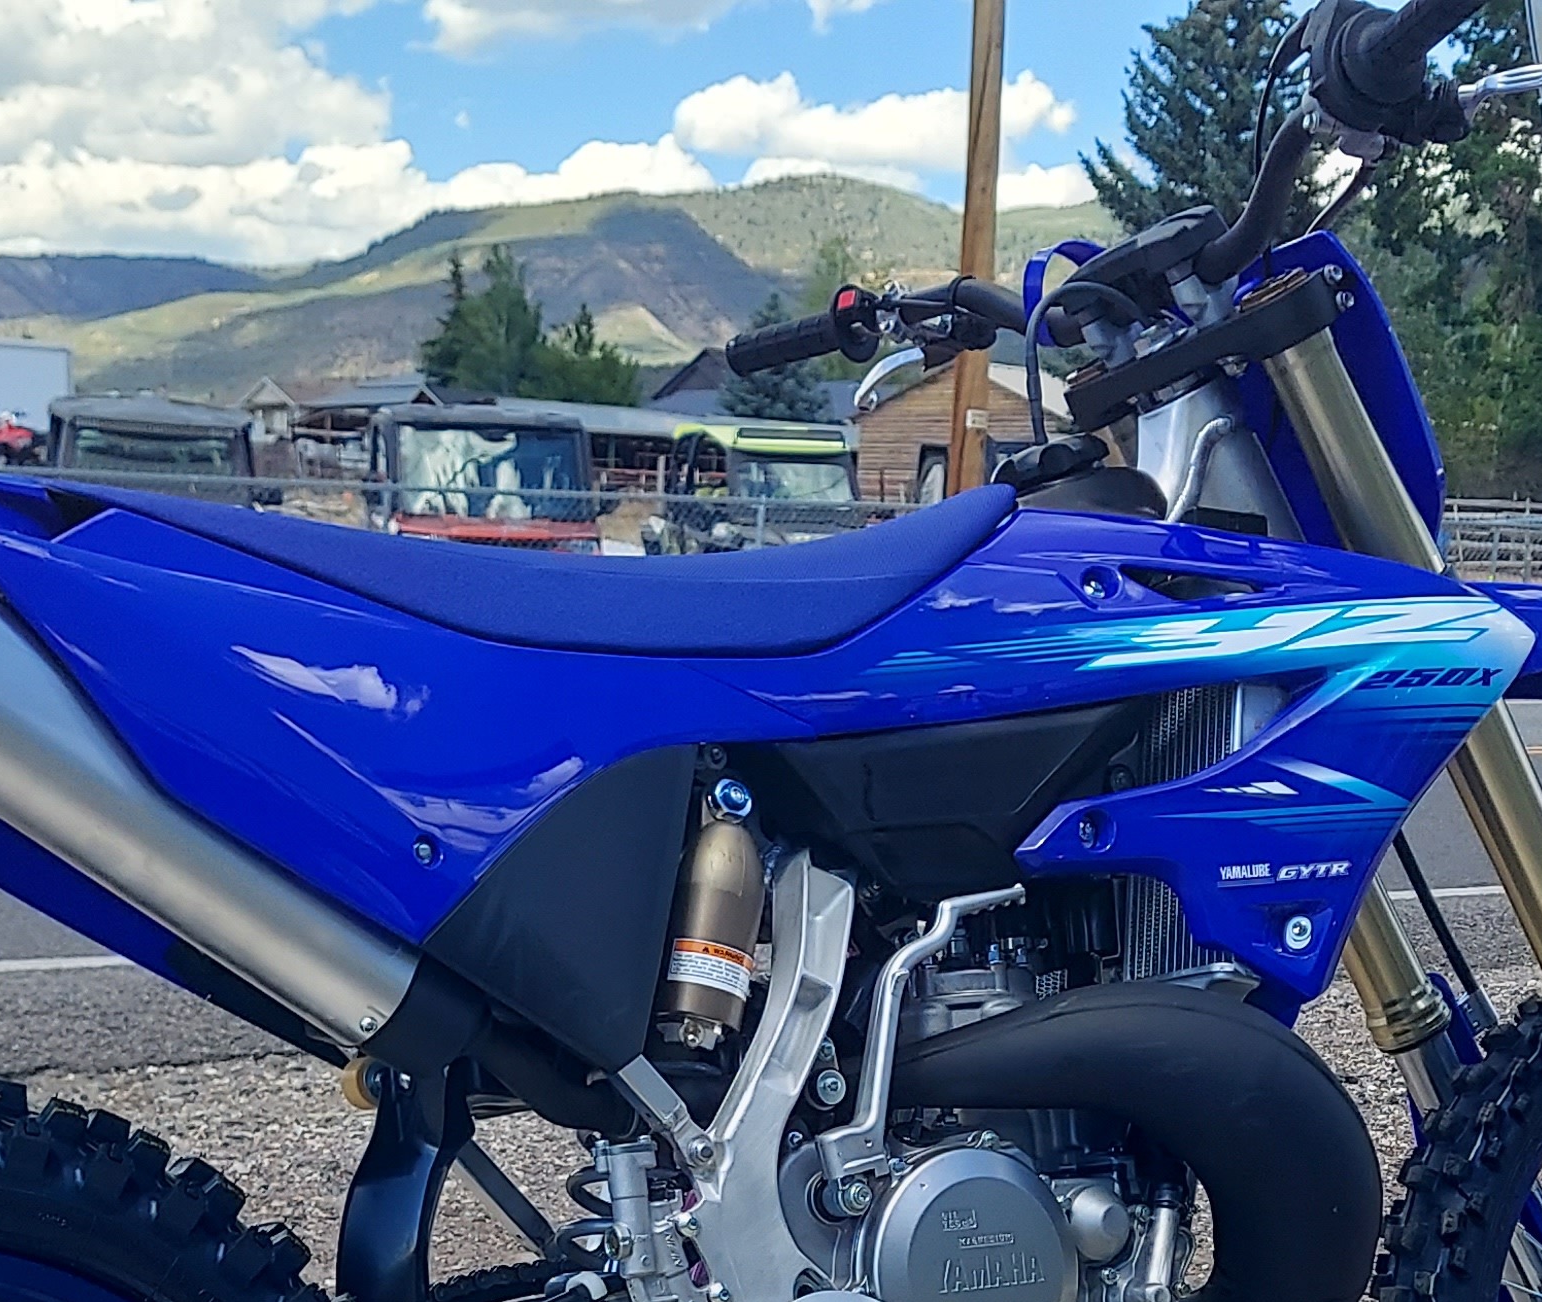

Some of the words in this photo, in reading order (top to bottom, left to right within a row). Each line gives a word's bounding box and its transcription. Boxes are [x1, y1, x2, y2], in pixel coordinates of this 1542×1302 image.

[1358, 667, 1503, 689] 250X
[1219, 863, 1271, 881] YAMALUBE
[1276, 860, 1352, 881] GYTR
[938, 1251, 1046, 1295] YAMAHA
